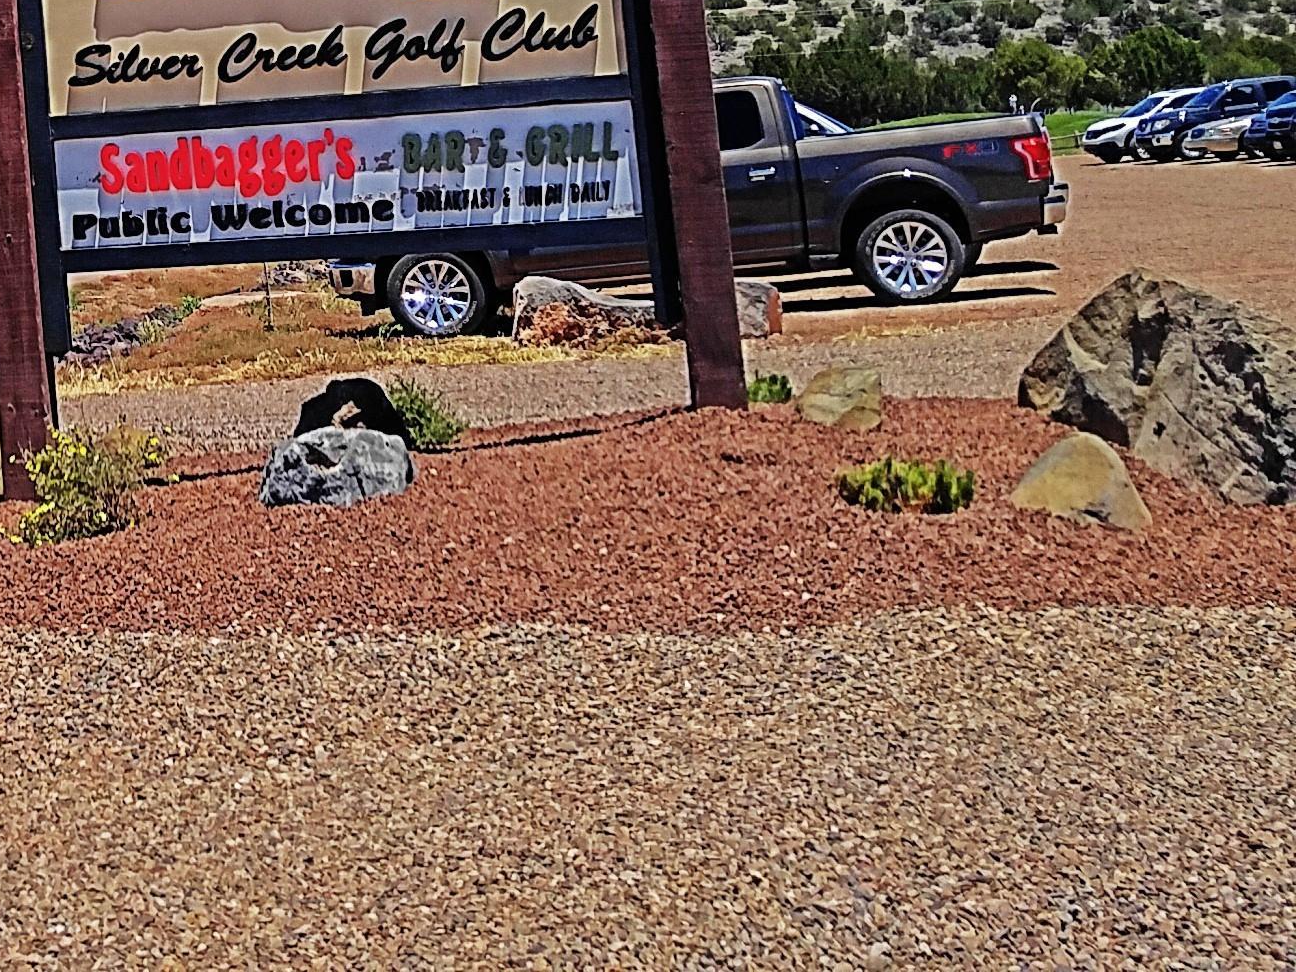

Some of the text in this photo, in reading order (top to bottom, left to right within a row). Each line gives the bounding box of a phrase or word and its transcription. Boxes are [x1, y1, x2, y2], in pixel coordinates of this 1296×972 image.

[68, 3, 599, 87] Silver Creek Golf Club
[99, 121, 620, 198] Sandbagger's BAR & GRILL
[72, 198, 395, 241] Public Welcome
[416, 187, 497, 213] BREAKFAST
[502, 186, 511, 208] &
[569, 179, 611, 204] DAILY
